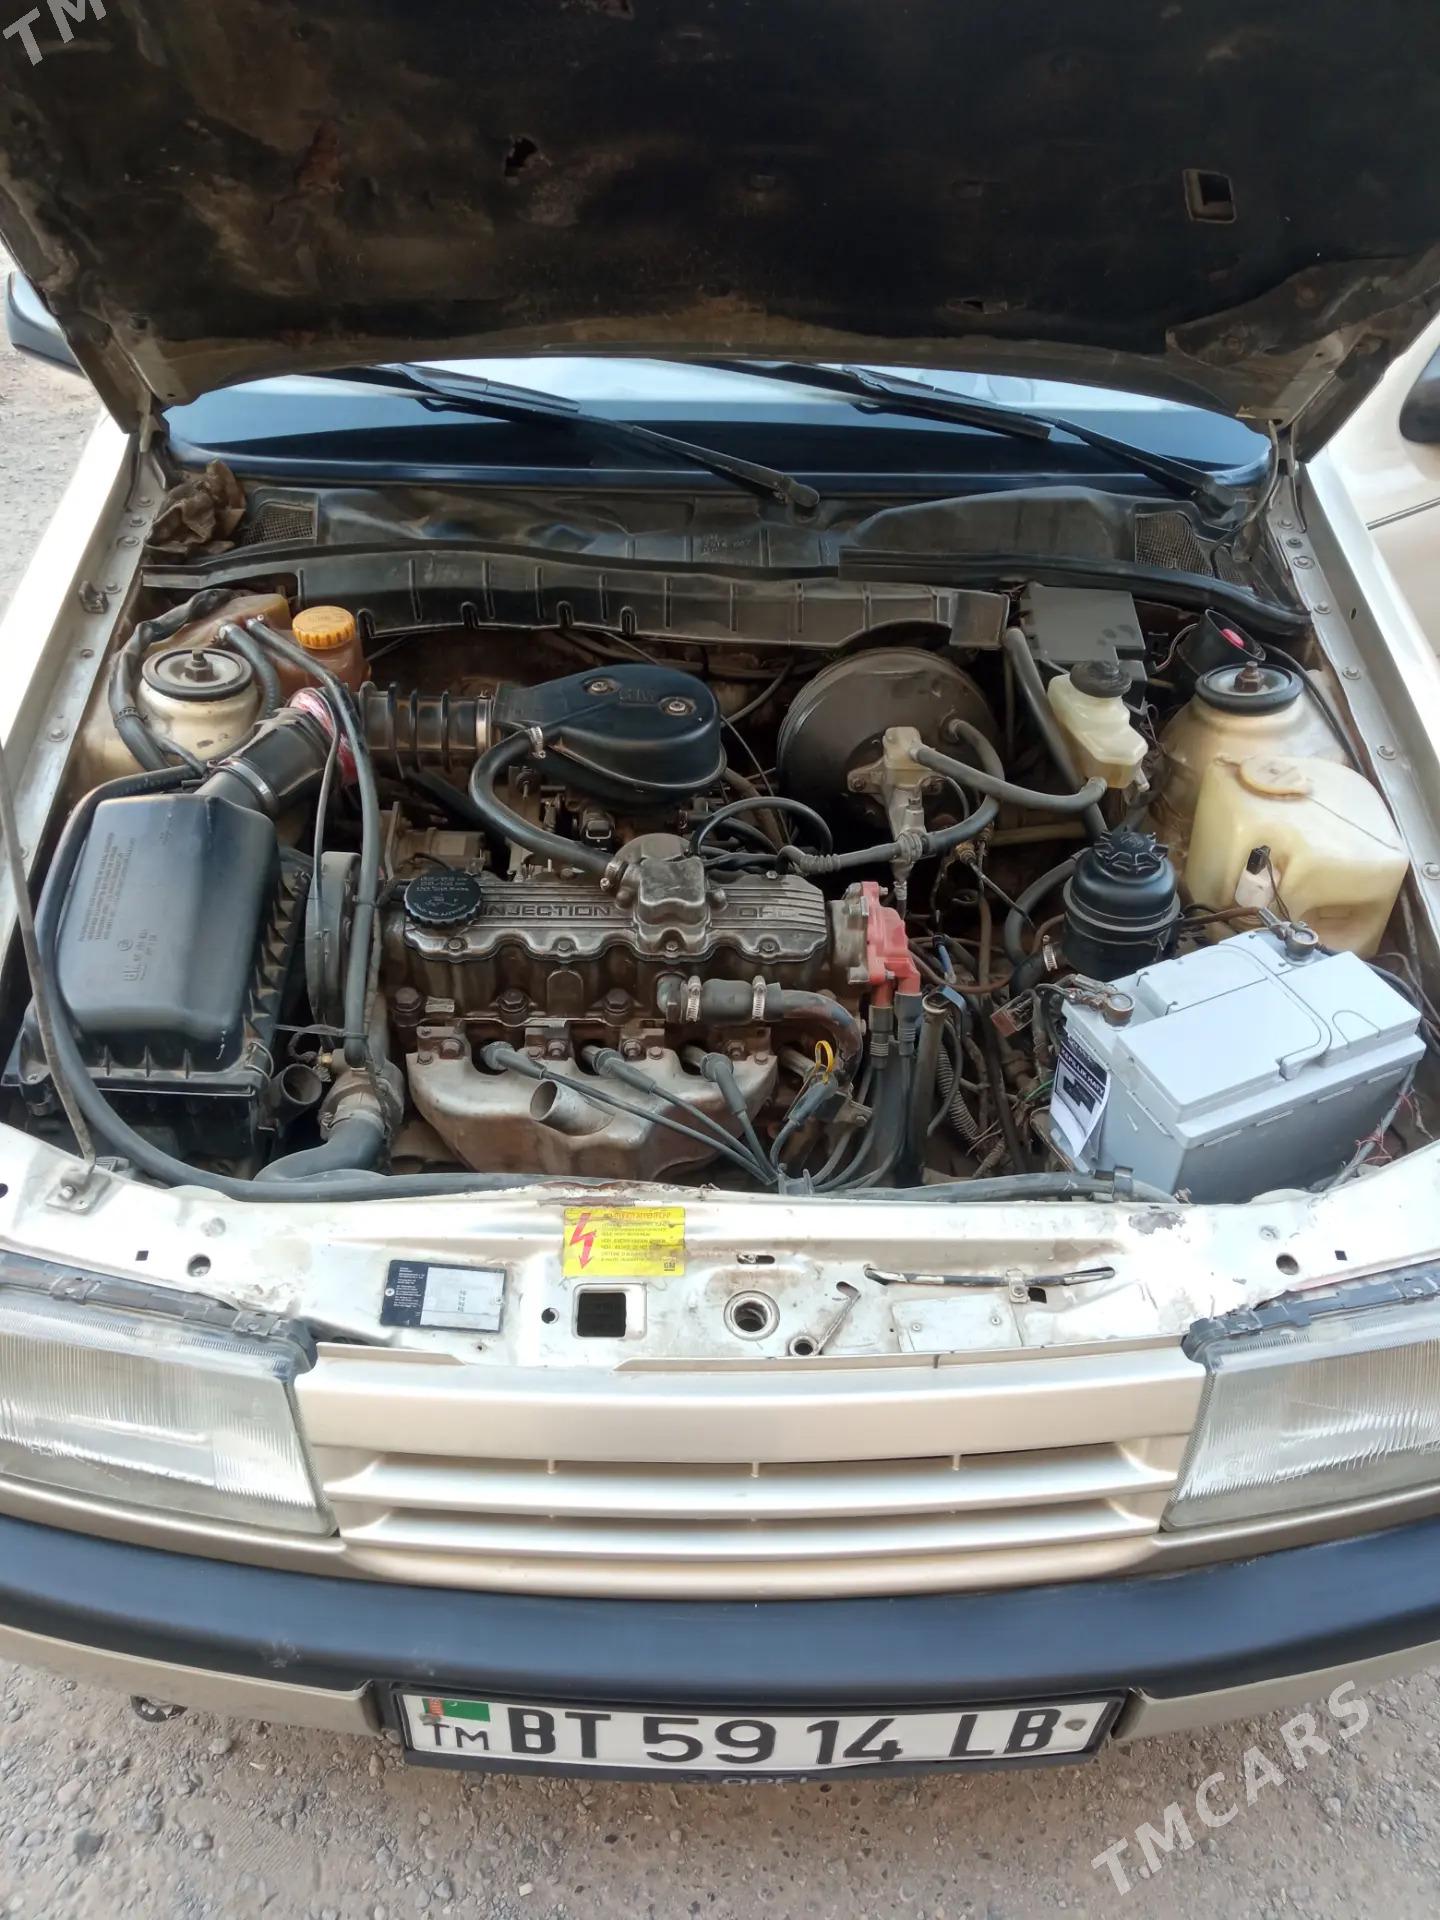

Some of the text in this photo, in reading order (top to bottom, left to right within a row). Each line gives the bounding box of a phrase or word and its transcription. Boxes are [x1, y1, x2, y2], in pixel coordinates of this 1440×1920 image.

[429, 1723, 490, 1751] TM
[509, 1708, 1059, 1765] BT 5914 LB
